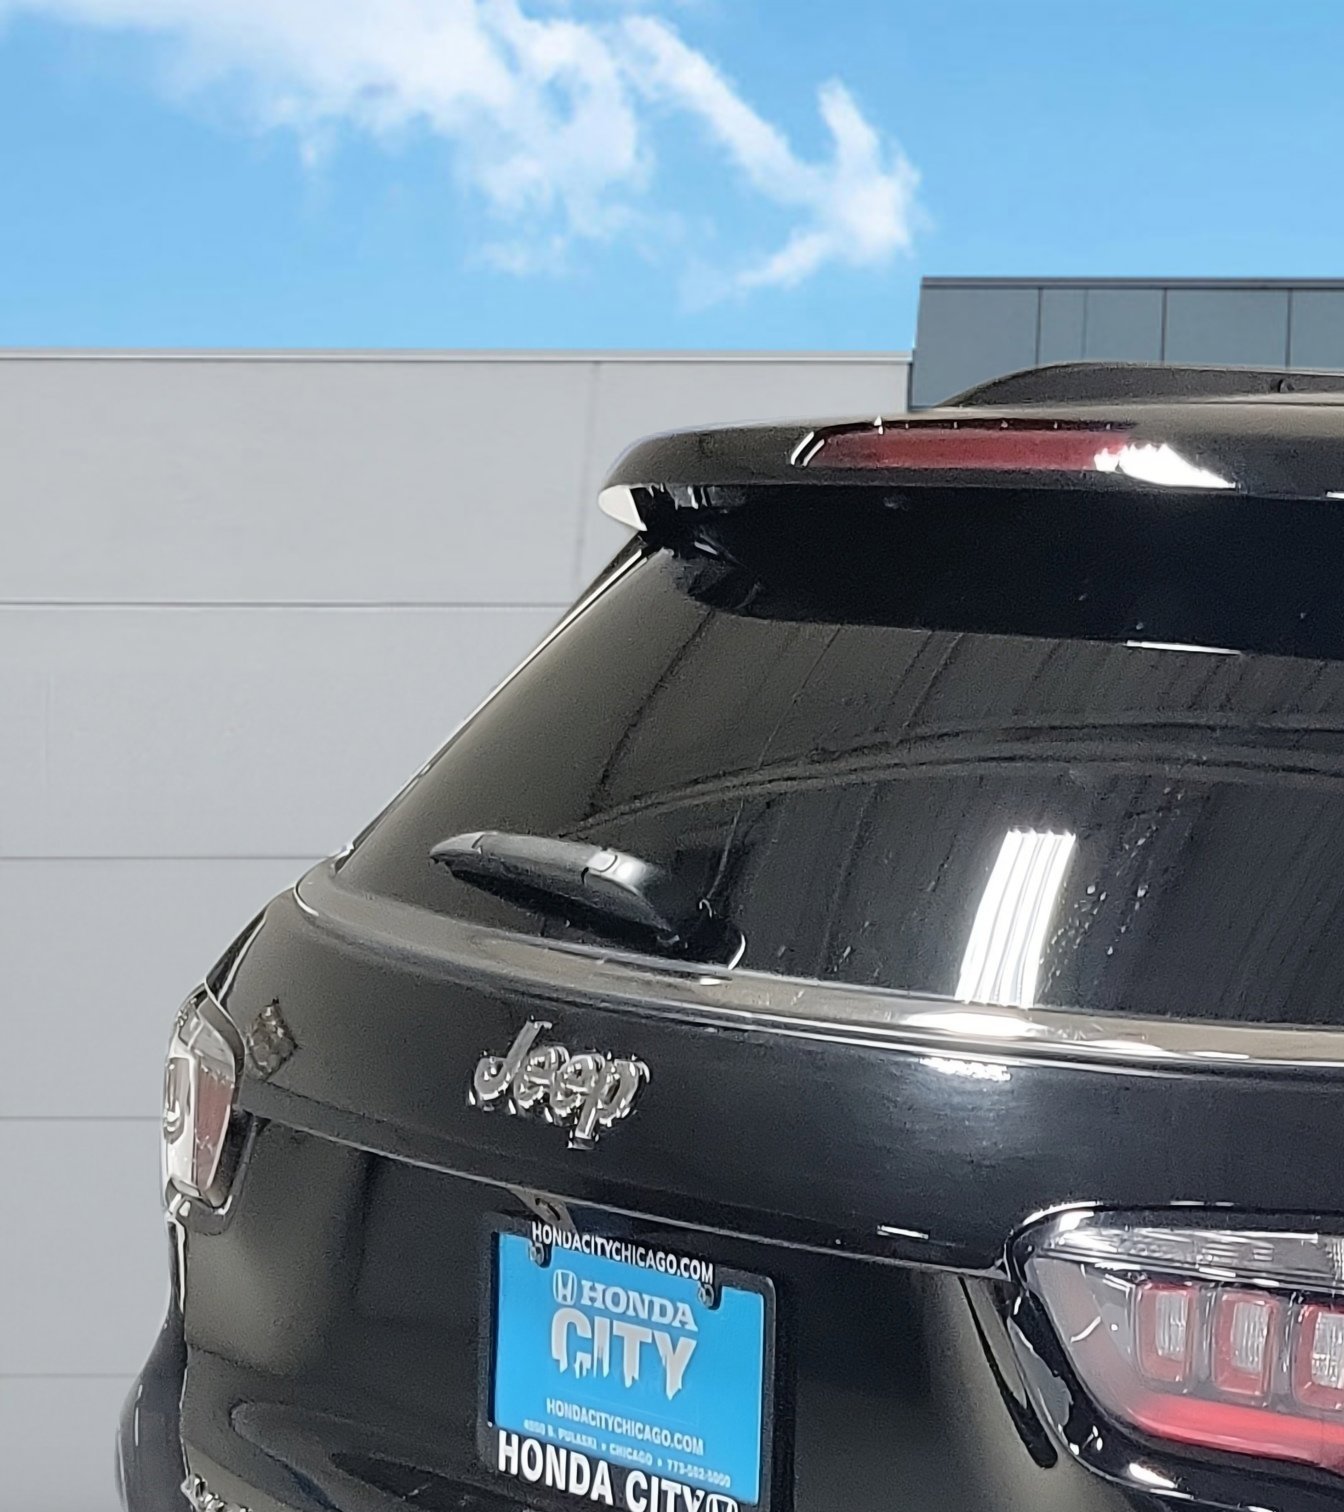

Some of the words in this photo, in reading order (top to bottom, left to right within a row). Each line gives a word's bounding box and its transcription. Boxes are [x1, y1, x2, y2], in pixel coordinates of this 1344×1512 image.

[470, 1017, 651, 1150] Jeep
[531, 1221, 714, 1284] HONDACITYCHICAGO.COM
[580, 1279, 699, 1332] HONDA
[550, 1307, 698, 1401] CITY
[546, 1397, 704, 1456] HONDACITYCHICAGO.COM
[609, 1443, 653, 1466] CHICAGO
[498, 1430, 614, 1507] HONDA
